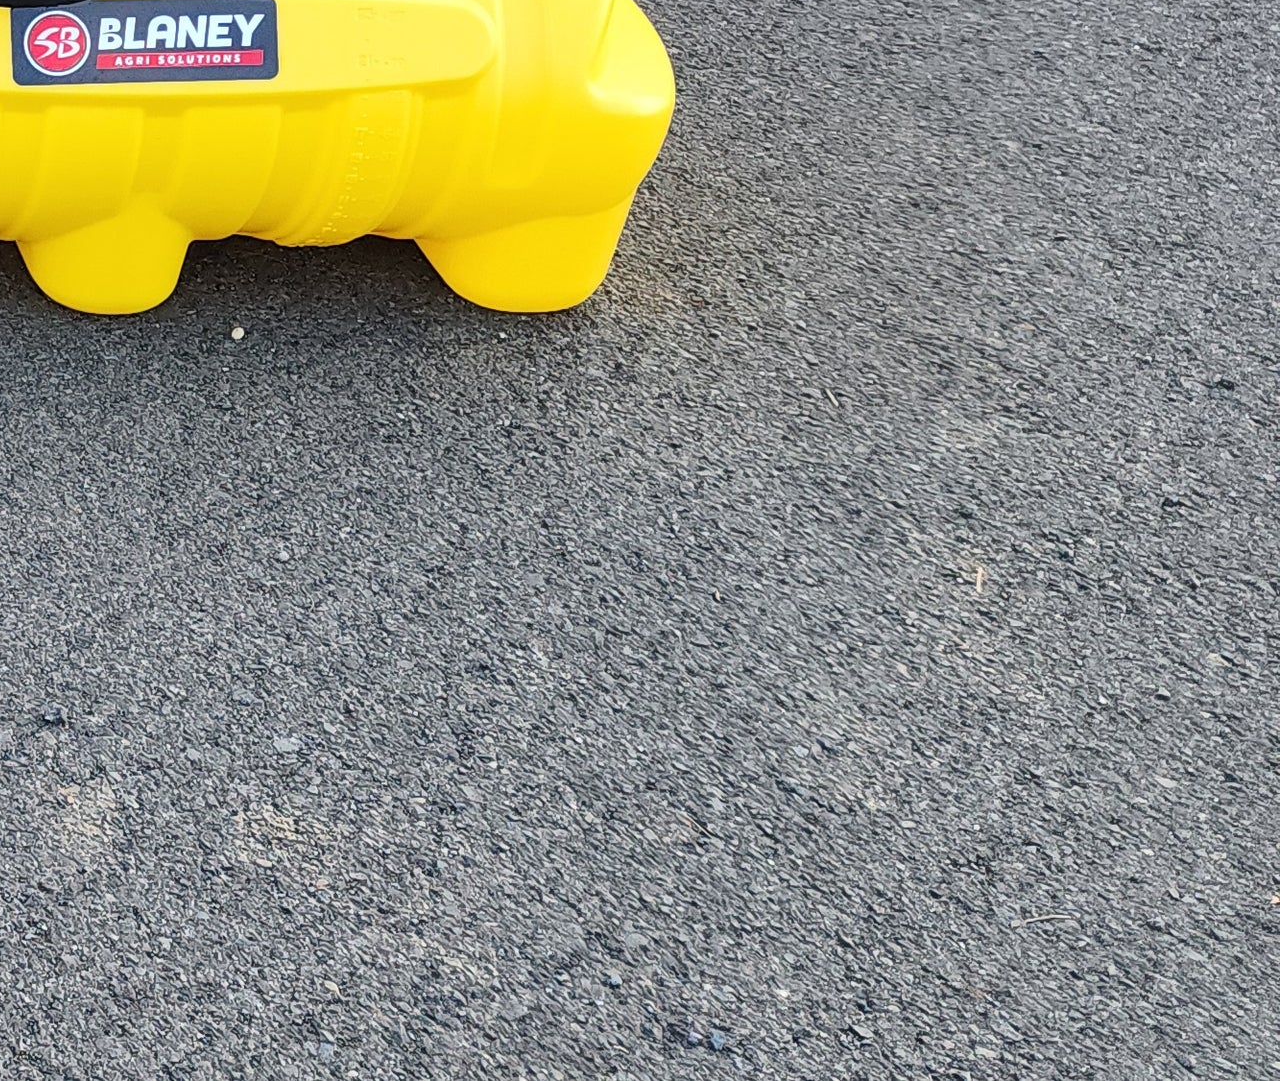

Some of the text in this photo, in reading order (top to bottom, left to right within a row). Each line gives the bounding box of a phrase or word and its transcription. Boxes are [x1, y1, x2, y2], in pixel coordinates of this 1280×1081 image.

[33, 14, 265, 60] SB BLANEY
[114, 52, 241, 66] AGRI SOLUTIONS
